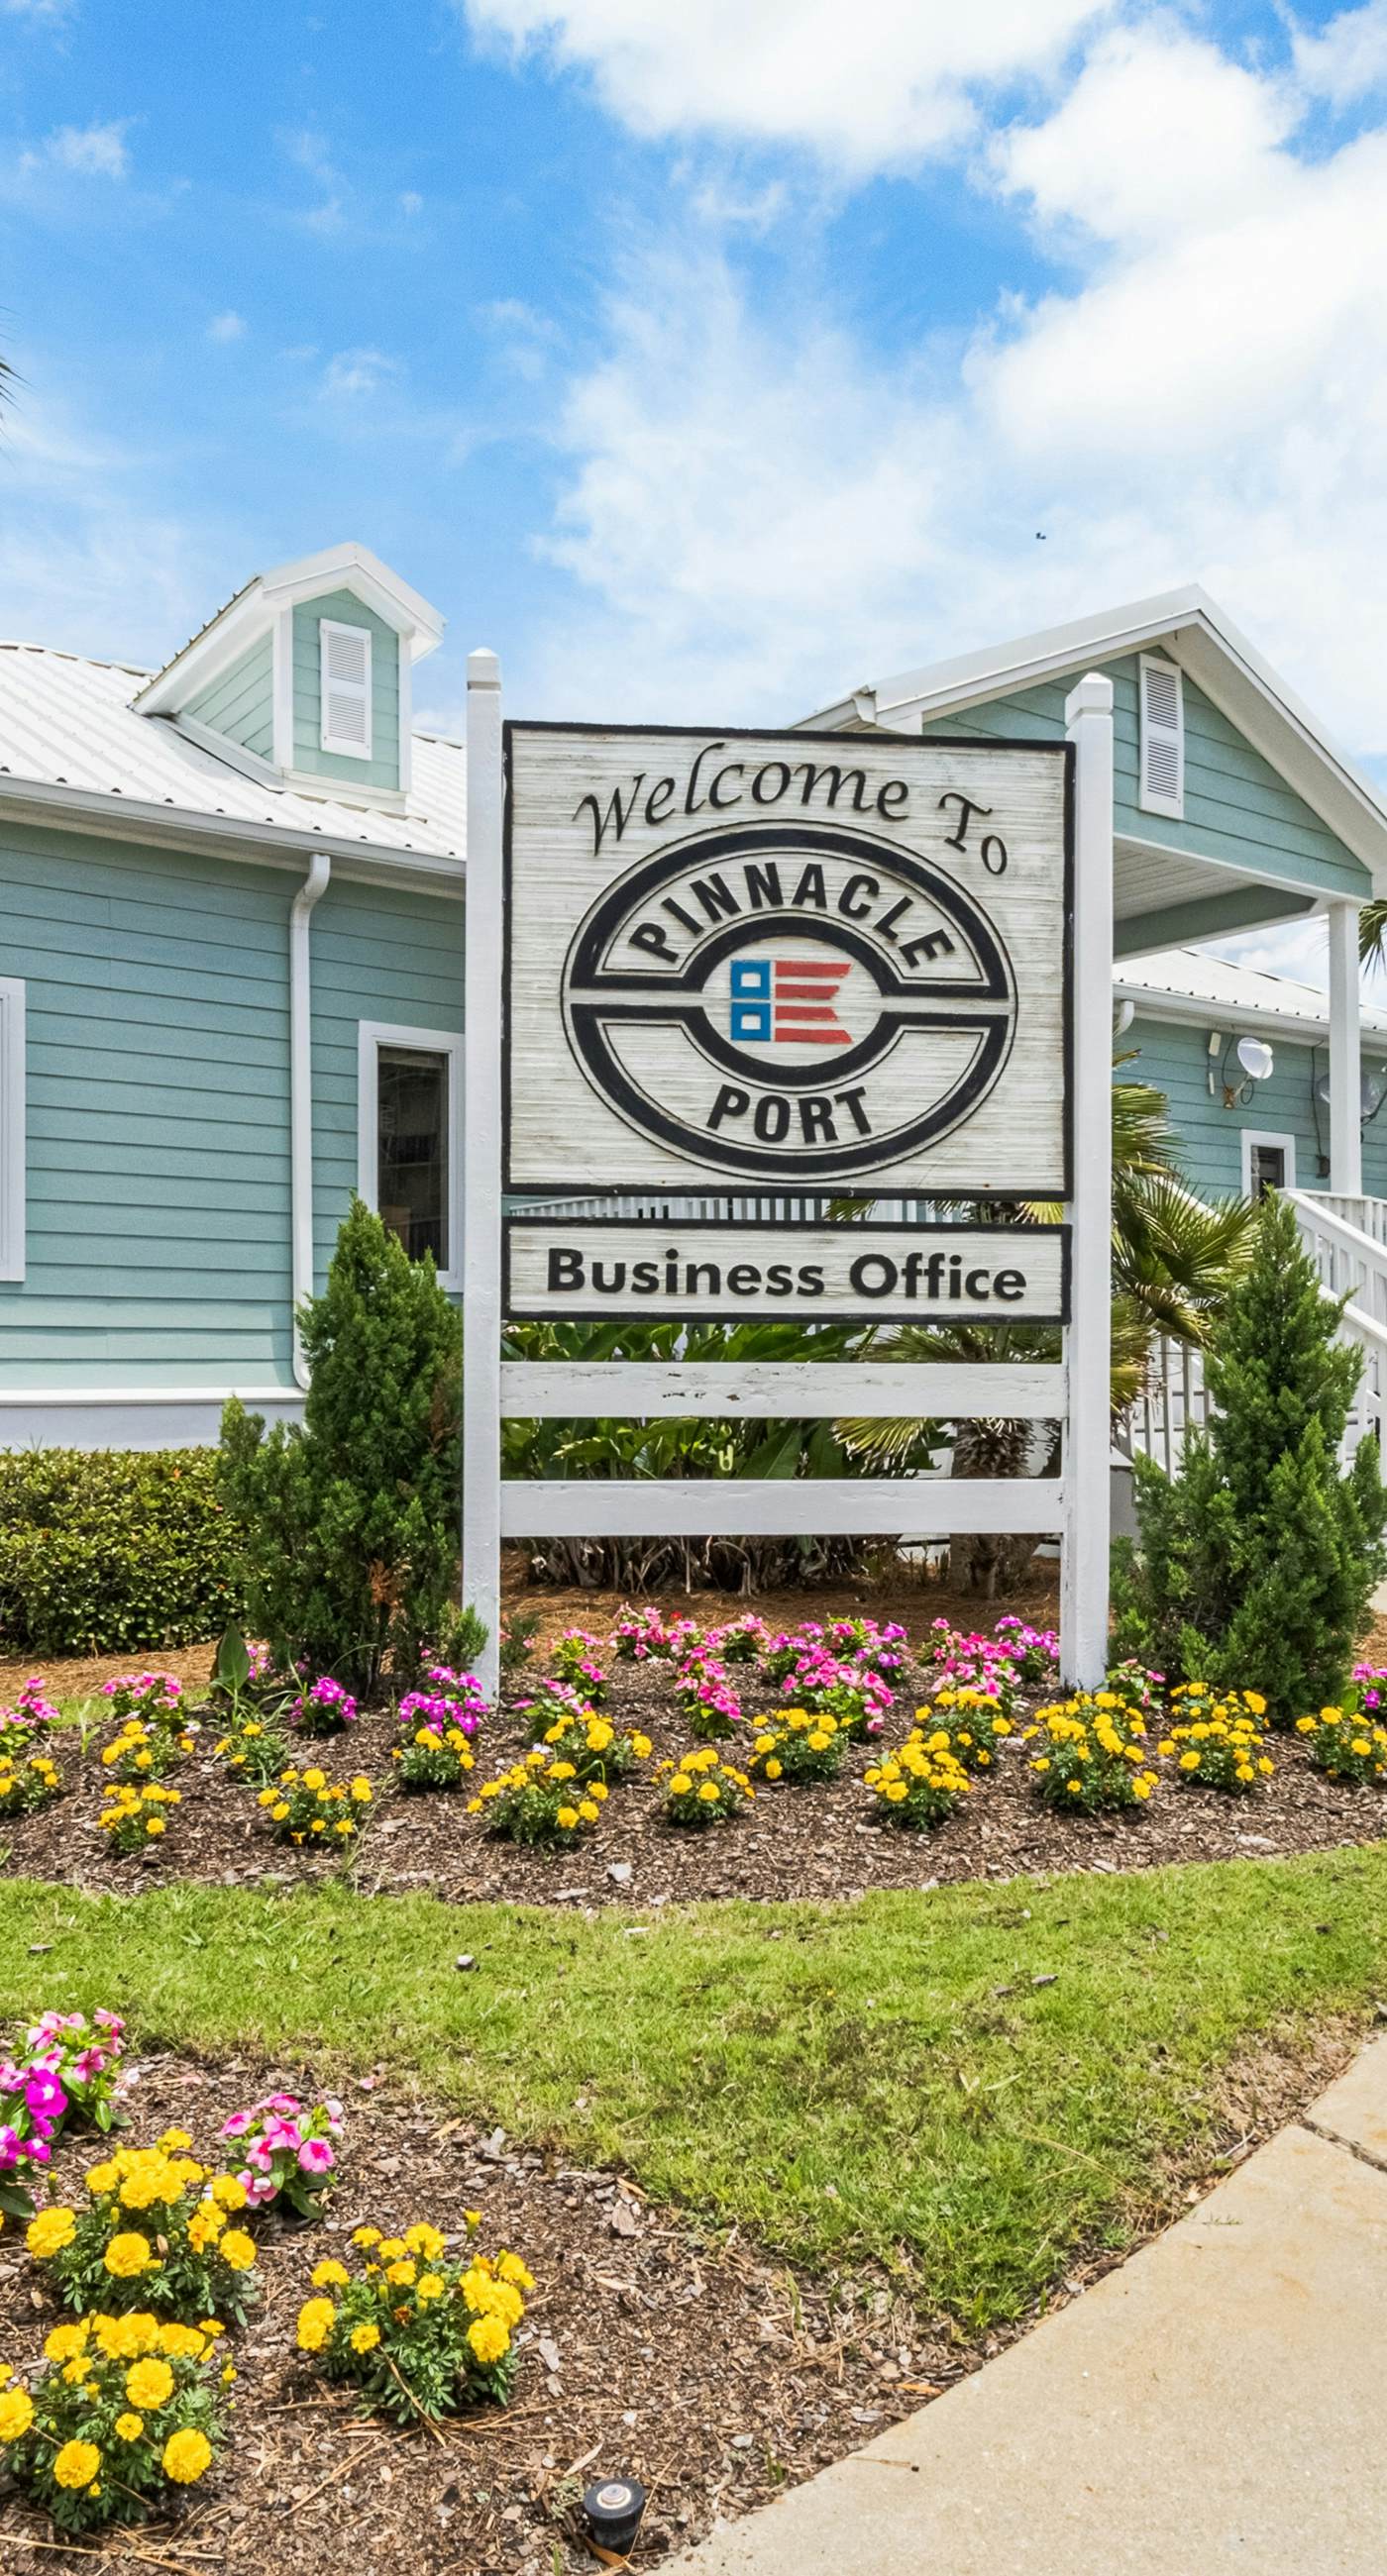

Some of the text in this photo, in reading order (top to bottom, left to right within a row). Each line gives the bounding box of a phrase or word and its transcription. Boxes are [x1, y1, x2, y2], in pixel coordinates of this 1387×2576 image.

[572, 742, 1008, 875] Welcome To
[628, 862, 955, 968] PINNACLE
[706, 1083, 873, 1144] PORT
[547, 1248, 1026, 1300] Business Office
